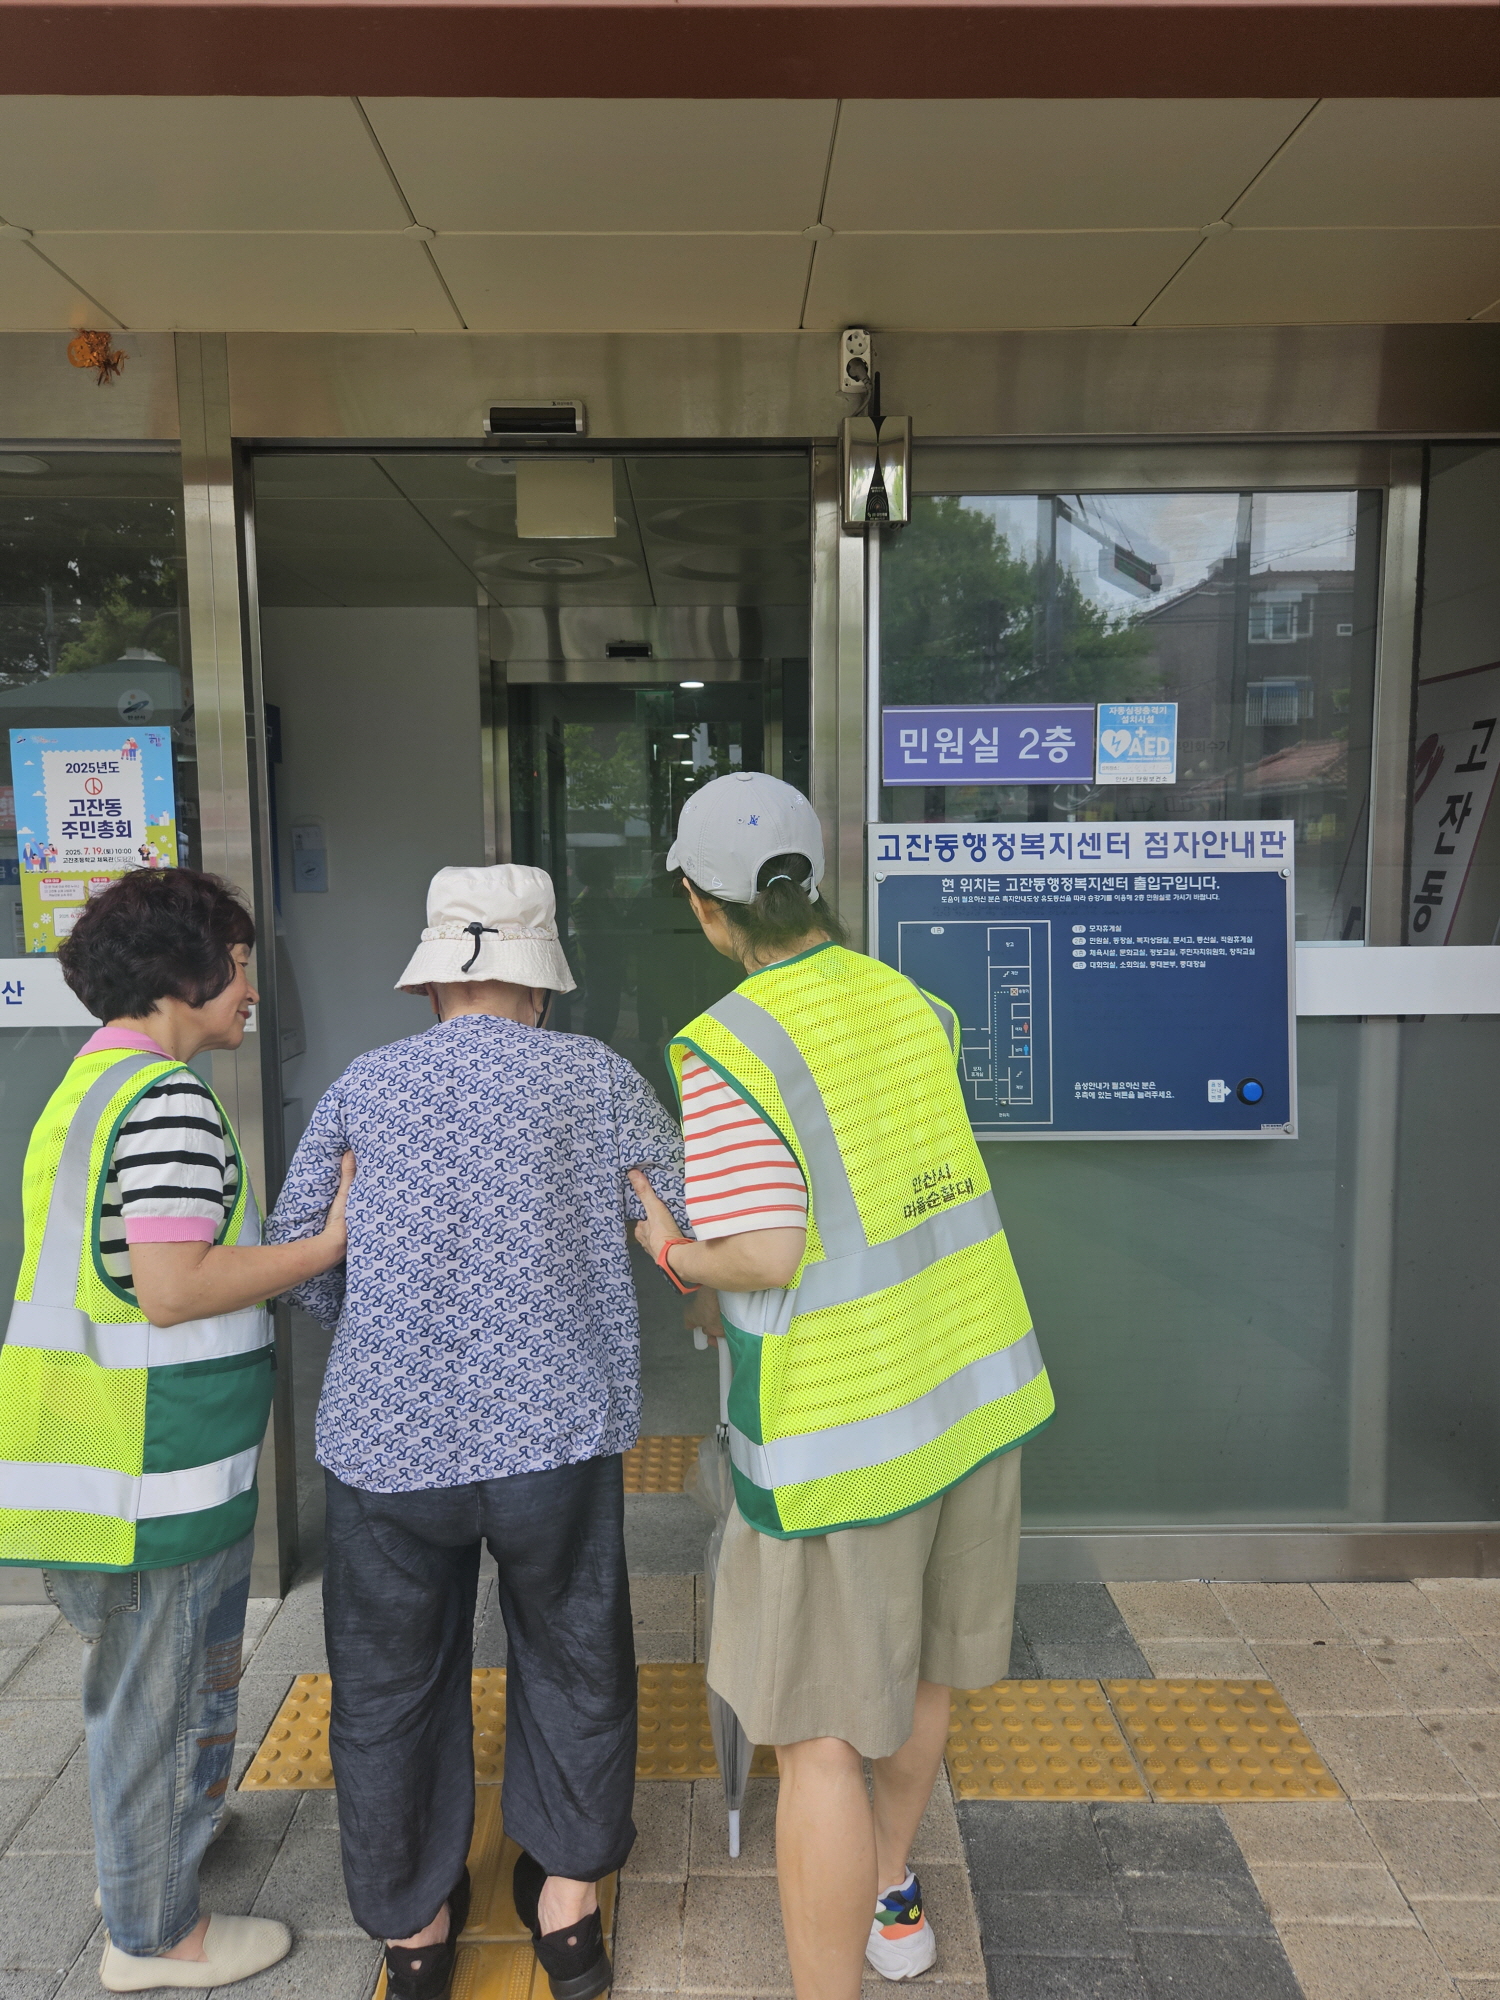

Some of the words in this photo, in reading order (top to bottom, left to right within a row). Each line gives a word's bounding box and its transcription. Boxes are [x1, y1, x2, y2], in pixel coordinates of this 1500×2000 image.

[1109, 706, 1168, 716] 자동심장충격기
[1121, 715, 1155, 724] 설치시설
[899, 727, 1000, 764] 민원실
[1018, 727, 1076, 763] 2층
[1128, 737, 1170, 756] AED
[65, 761, 120, 774] 2025년도
[69, 798, 122, 817] 고잔동
[61, 819, 132, 840] 주민총회
[1413, 717, 1497, 933] 고잔동
[876, 831, 1131, 862] 고잔동행정복지센터
[1144, 830, 1287, 859] 점자안내판
[941, 877, 955, 893] 현
[960, 877, 1001, 893] 위치는
[1005, 876, 1129, 892] 고잔동행정복지센터
[1133, 875, 1221, 891] 출입구입니다.
[941, 895, 960, 904] 도움이
[1087, 894, 1113, 902] 승강기를
[1113, 894, 1133, 902] 이용해
[1193, 893, 1221, 901] 바랍니다.
[1089, 937, 1112, 945] 민원실,
[0, 980, 25, 1005] 산
[1074, 1082, 1110, 1090] 음성안내가
[1111, 1082, 1140, 1090] 필요하신
[1141, 1081, 1156, 1090] 분은
[1074, 1091, 1096, 1099] 우측에
[1097, 1091, 1112, 1099] 있는
[1113, 1091, 1136, 1099] 버튼을
[909, 1904, 920, 1920] GEL
